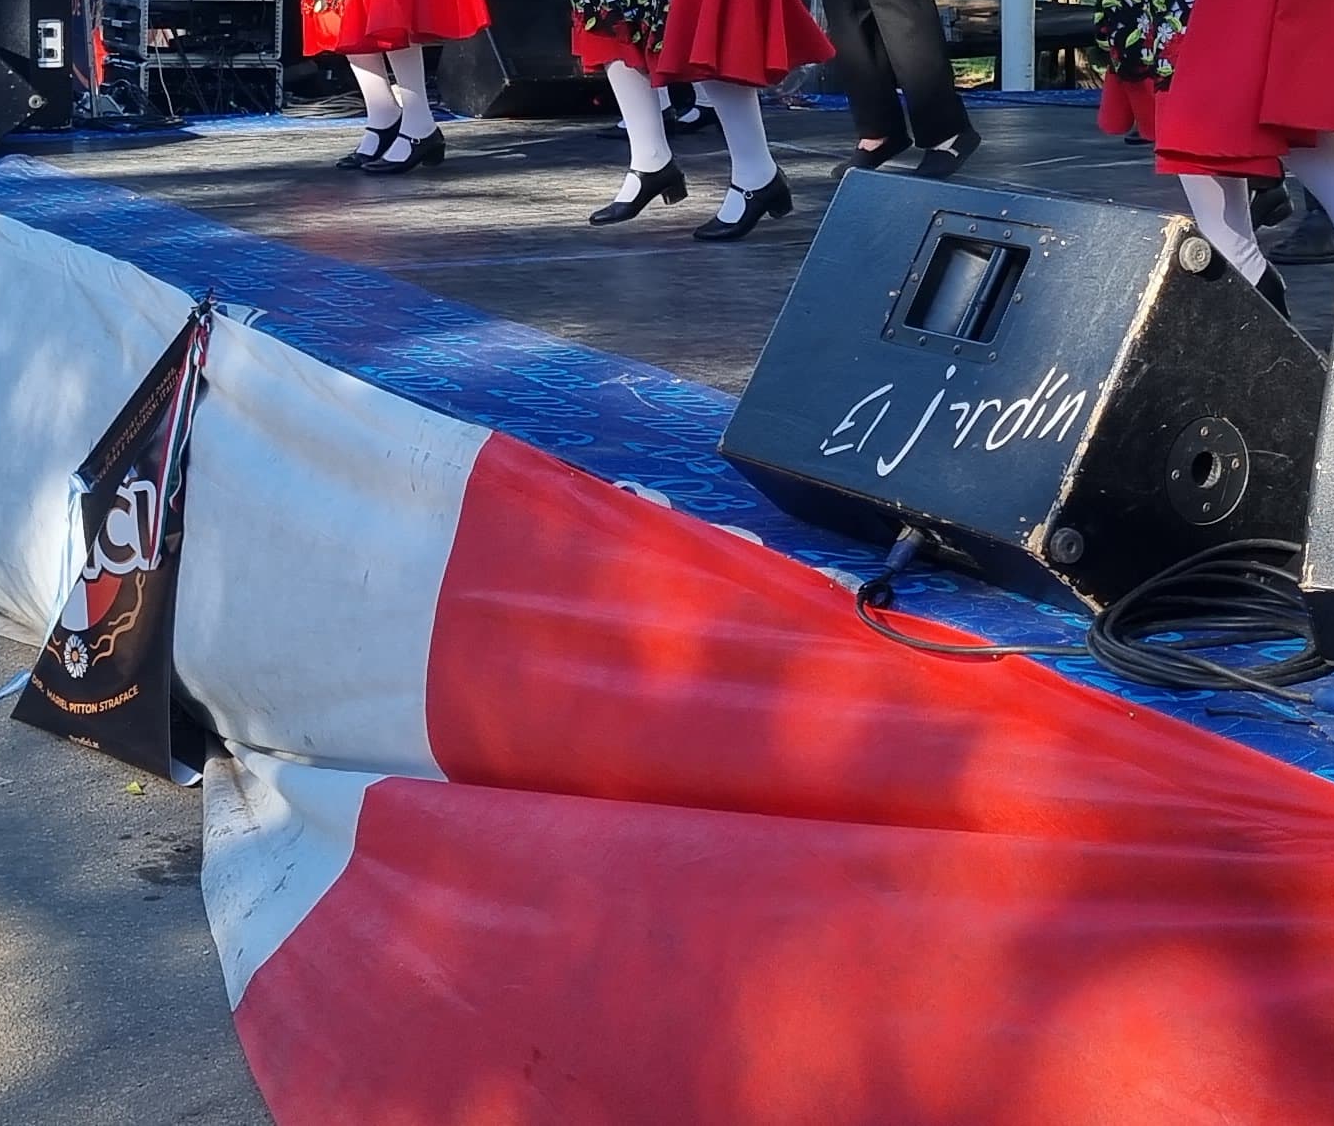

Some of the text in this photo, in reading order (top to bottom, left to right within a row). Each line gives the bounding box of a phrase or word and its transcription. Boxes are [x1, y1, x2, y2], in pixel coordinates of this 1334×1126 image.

[819, 383, 894, 456] El
[69, 702, 98, 715] PITTON
[99, 684, 140, 712] STRAFACE
